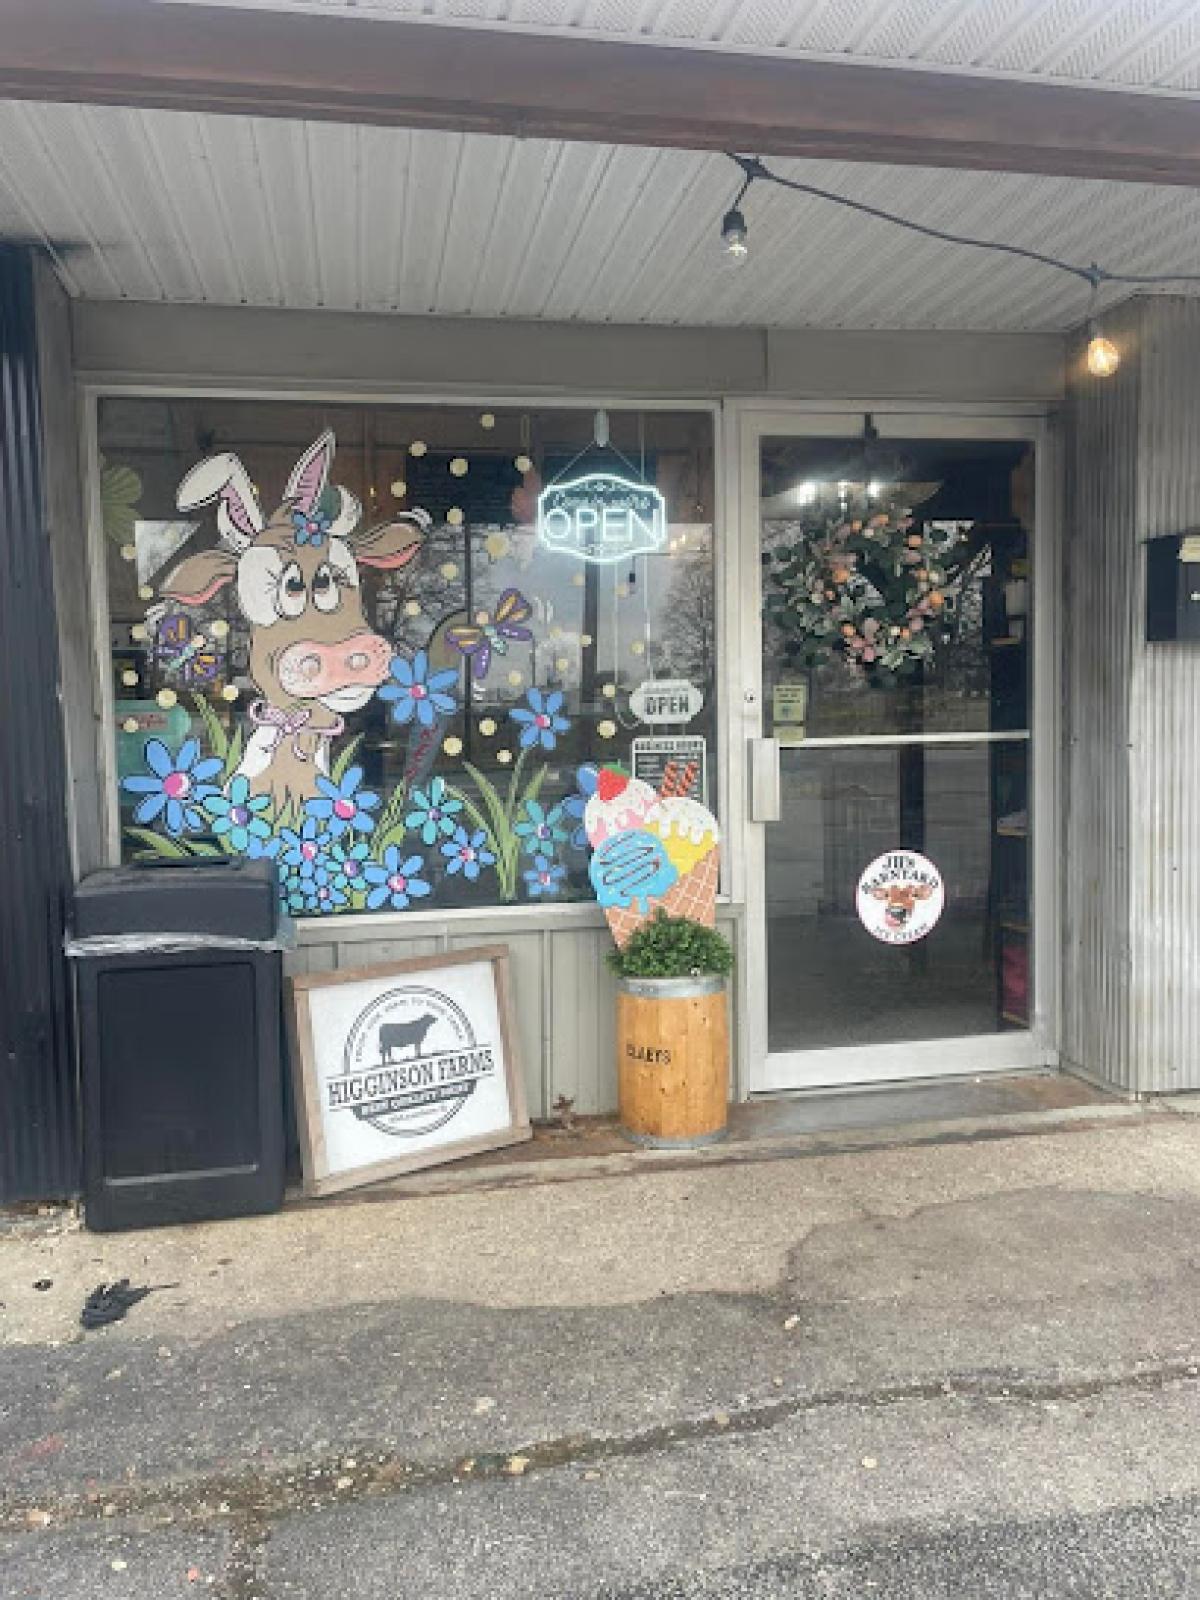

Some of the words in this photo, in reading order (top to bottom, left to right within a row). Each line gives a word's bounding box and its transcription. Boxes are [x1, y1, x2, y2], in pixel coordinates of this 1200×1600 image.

[546, 507, 659, 543] OPEN
[644, 694, 689, 715] OPEN
[328, 1062, 434, 1107] HIGGINSON
[437, 1049, 495, 1081] FARMS
